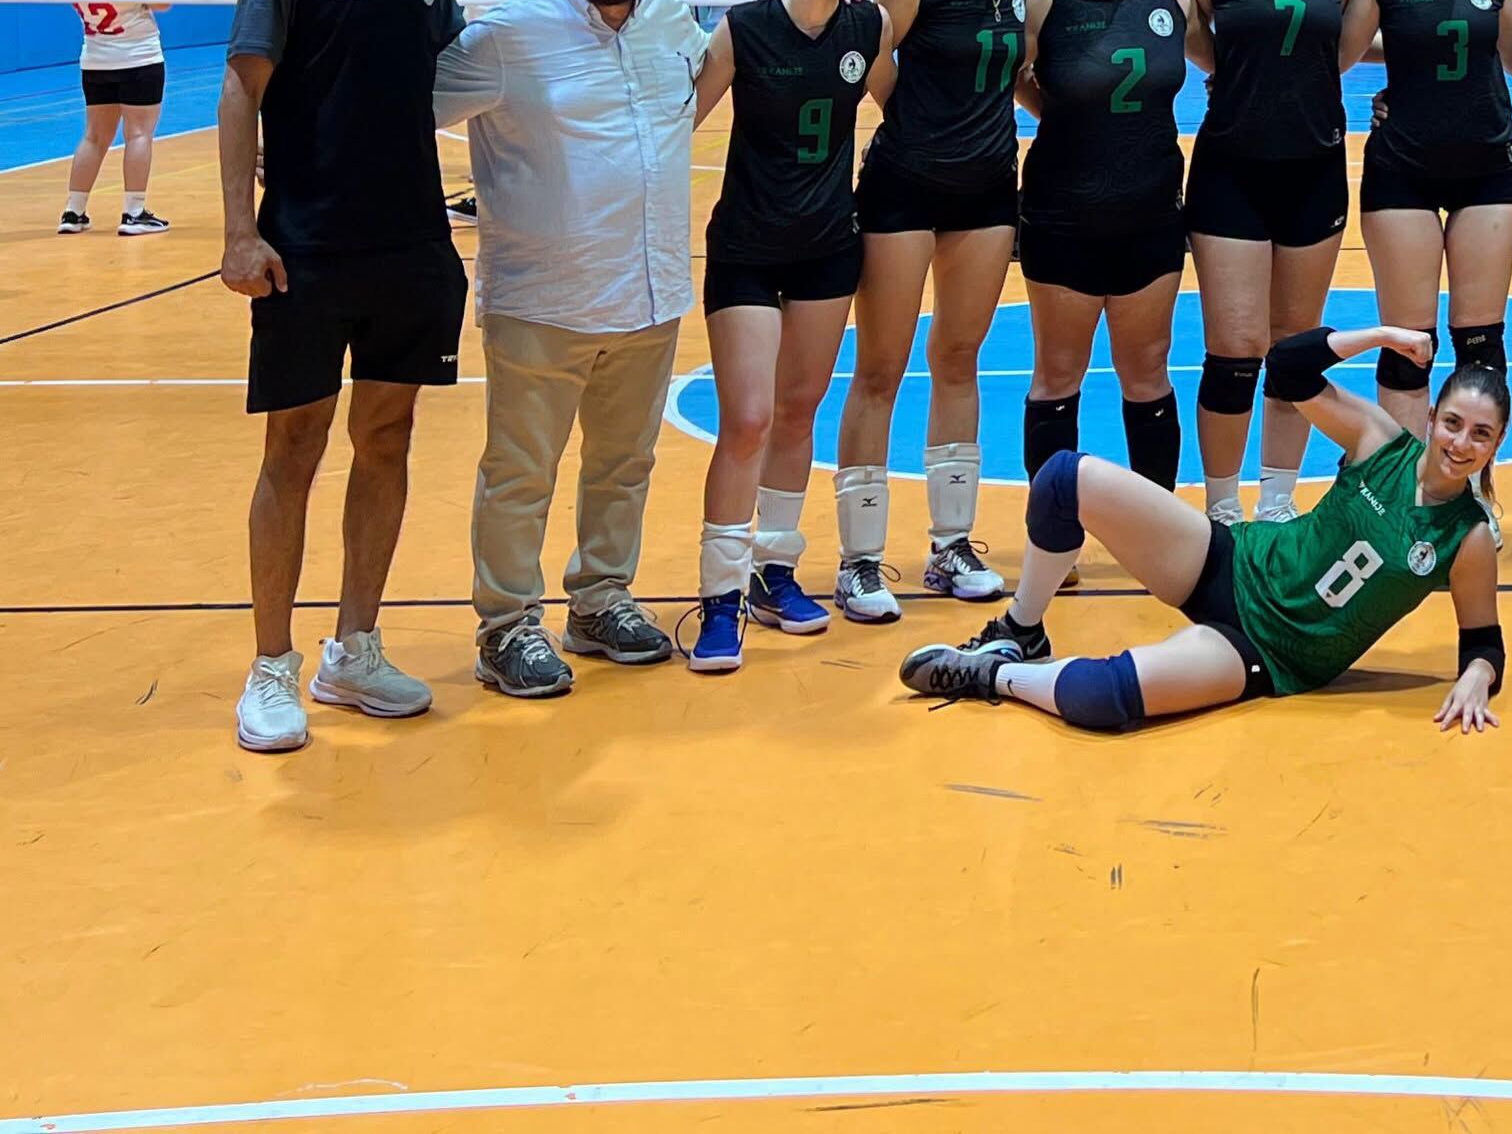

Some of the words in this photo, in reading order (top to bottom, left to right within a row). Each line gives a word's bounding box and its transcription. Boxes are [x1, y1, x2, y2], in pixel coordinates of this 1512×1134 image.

[975, 30, 1017, 93] 11
[1110, 48, 1146, 113] 2
[1436, 20, 1468, 81] 3
[798, 98, 833, 163] 9
[1314, 540, 1384, 608] 8
